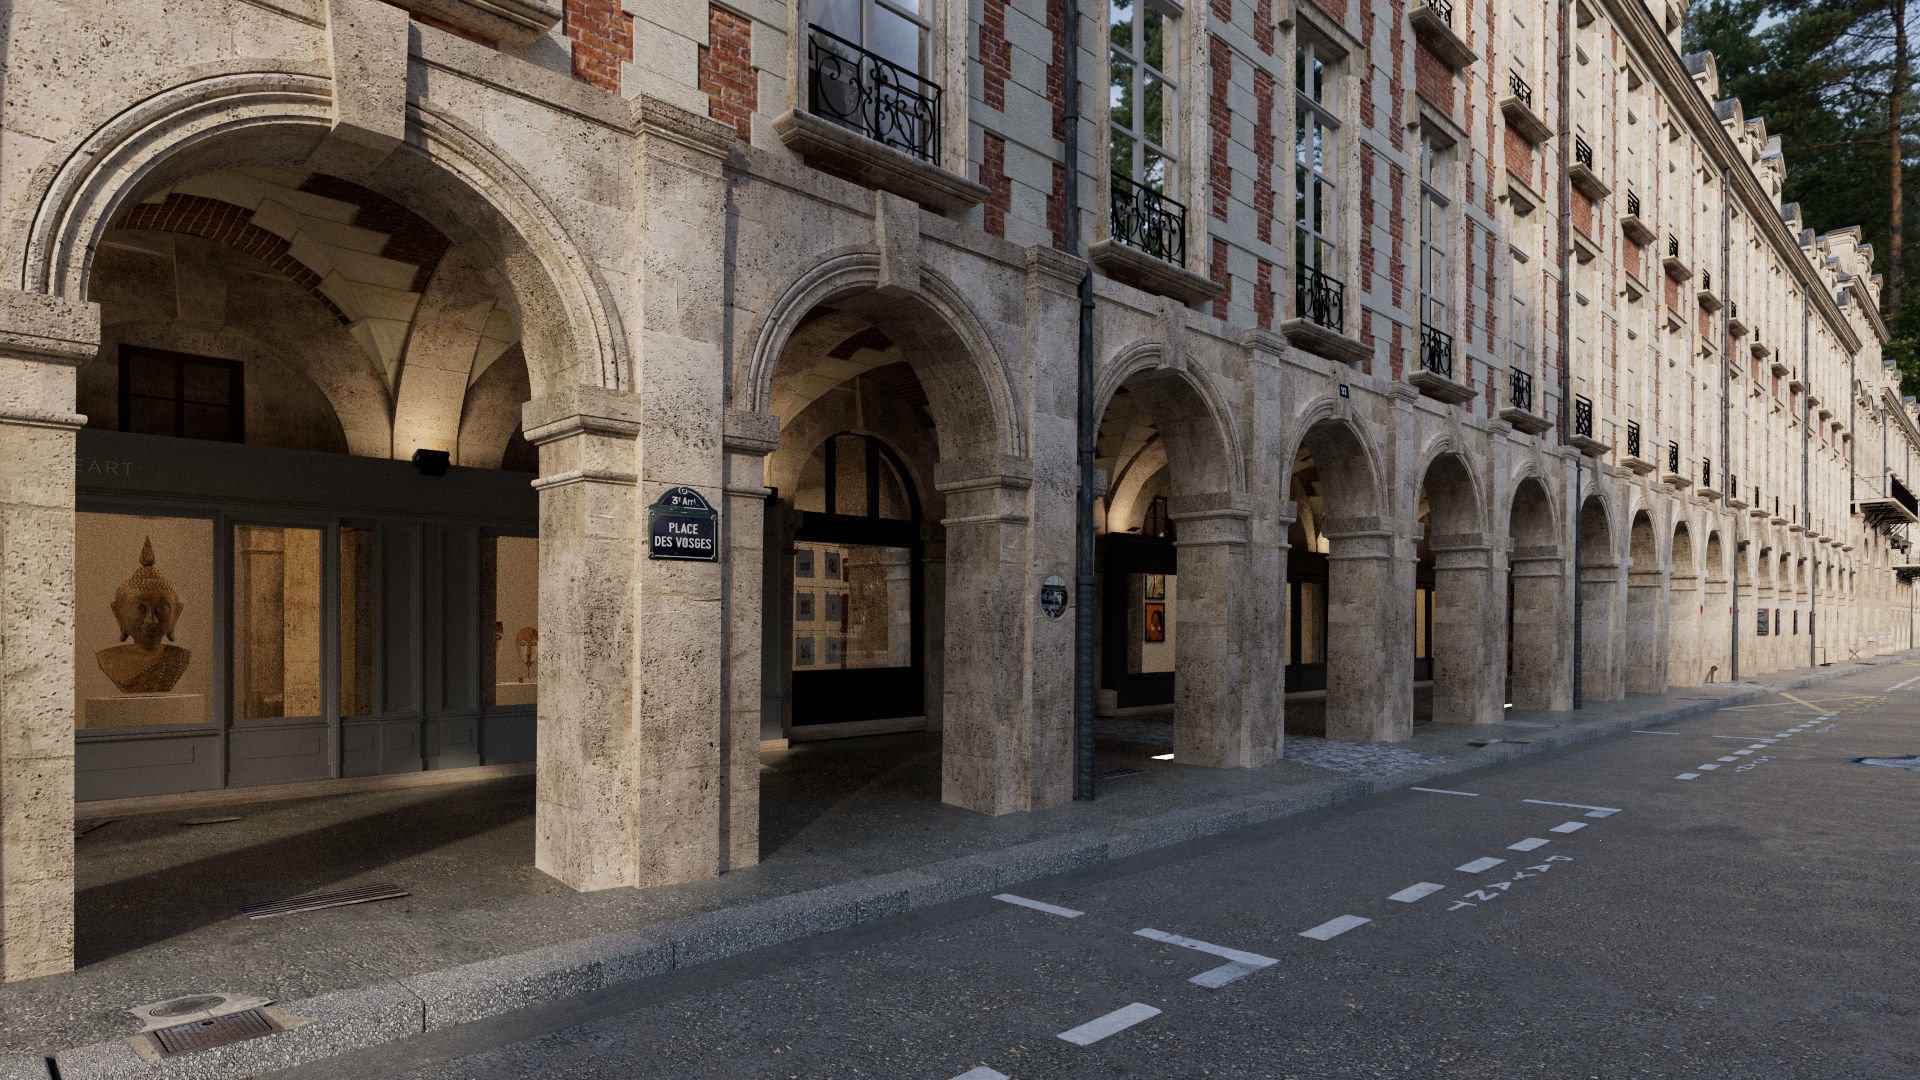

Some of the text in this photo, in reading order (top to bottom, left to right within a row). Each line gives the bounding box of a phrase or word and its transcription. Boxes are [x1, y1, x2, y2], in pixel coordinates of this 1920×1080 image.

[668, 522, 699, 534] PLACE
[654, 535, 712, 550] DES VOSGES
[1445, 855, 1575, 912] PAYANT
